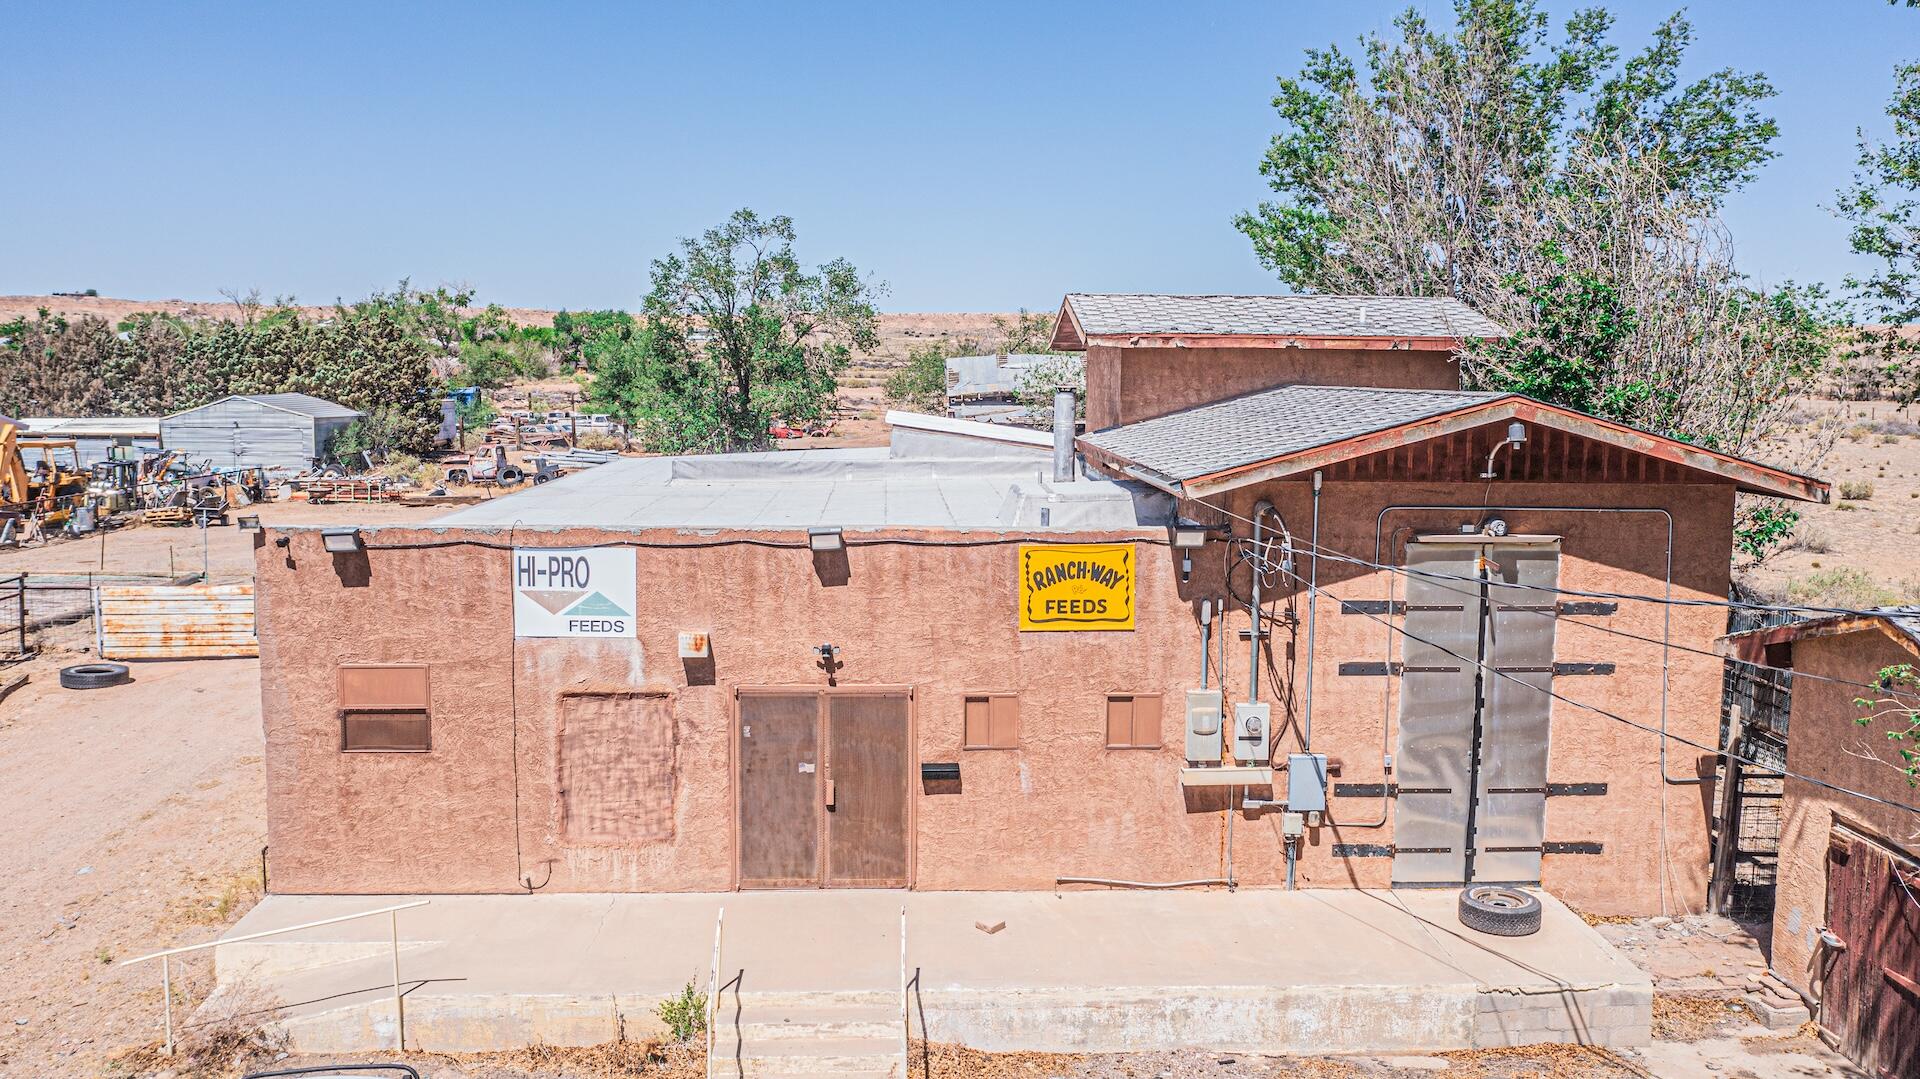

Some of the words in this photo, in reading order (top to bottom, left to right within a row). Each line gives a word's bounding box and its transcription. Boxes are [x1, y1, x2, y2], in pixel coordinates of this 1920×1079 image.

[518, 556, 590, 588] HI-PRO
[1045, 599, 1107, 614] FEEDS
[569, 620, 625, 633] FEEDS
